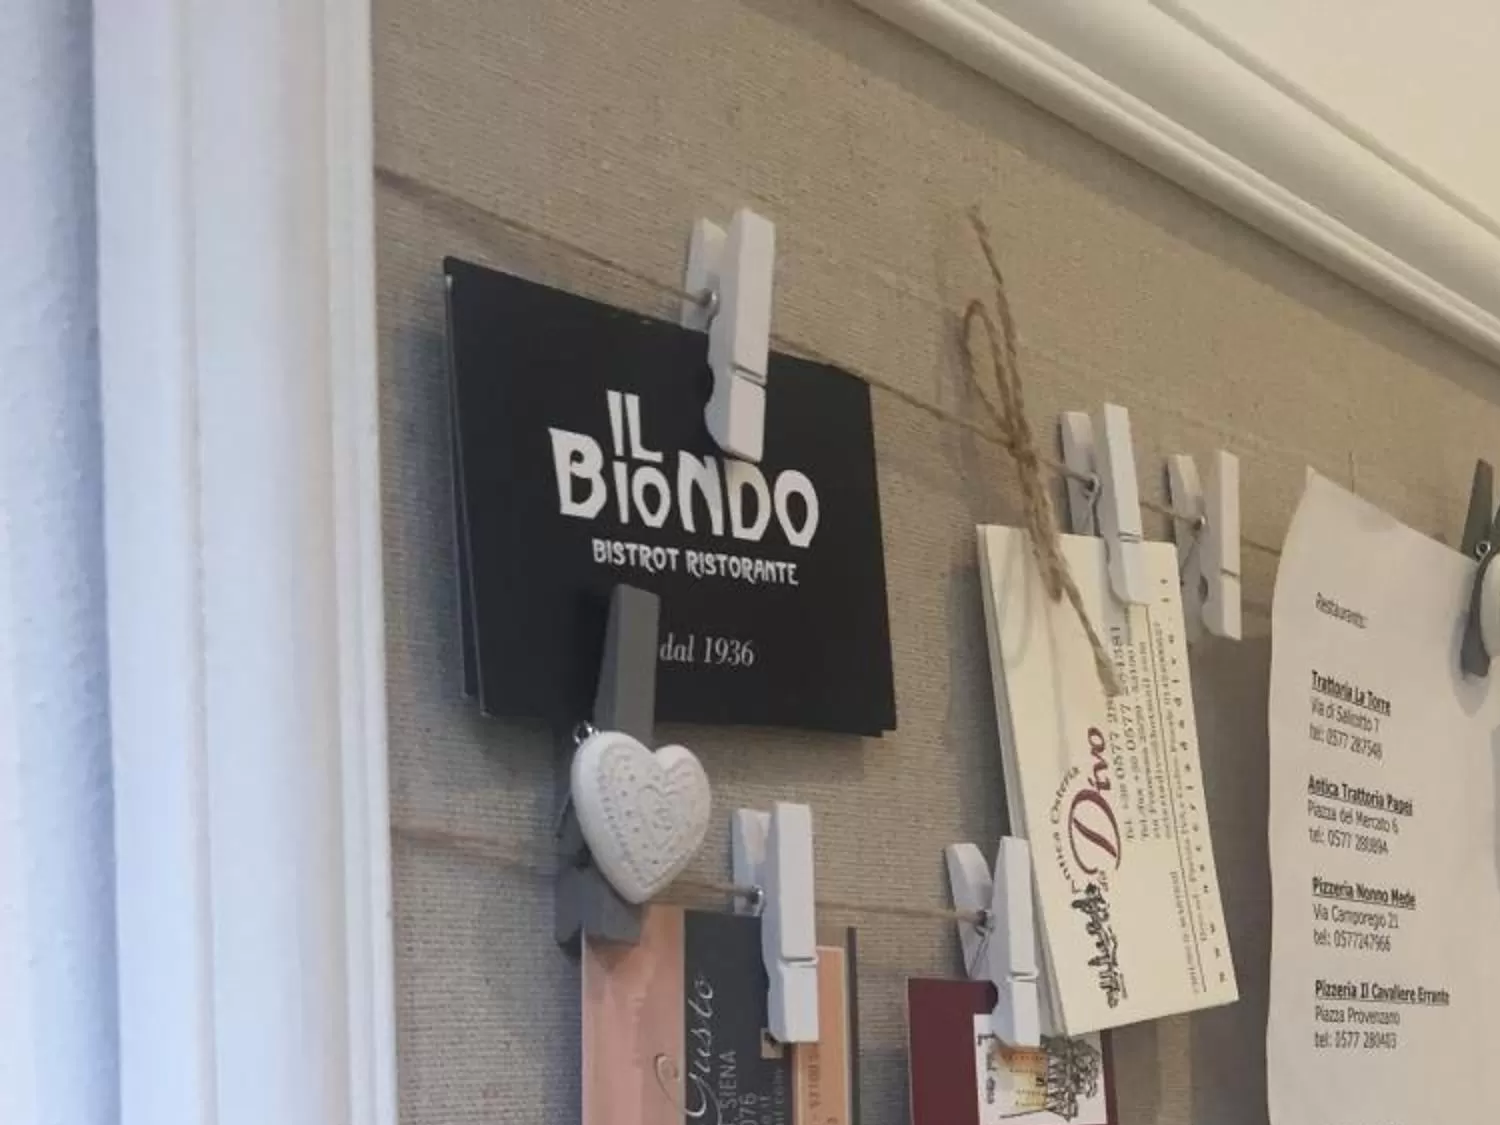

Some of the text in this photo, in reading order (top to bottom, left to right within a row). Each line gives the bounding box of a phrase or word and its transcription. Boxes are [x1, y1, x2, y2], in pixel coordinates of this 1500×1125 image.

[607, 389, 664, 463] IL
[548, 427, 820, 549] BIONDO
[591, 537, 799, 586] BISTROT RISTORANTE
[659, 634, 755, 667] dal 1936
[1312, 668, 1353, 702] Trattoria
[1066, 726, 1122, 876] Divo
[1307, 773, 1340, 798] Antica
[1341, 782, 1384, 808] Trattoria
[1307, 798, 1337, 821] Piazza
[1312, 876, 1354, 899] Pizzeria
[1356, 882, 1389, 903] Nonno
[1312, 903, 1329, 921] Via
[1315, 979, 1357, 1000] Pizzeria
[1371, 982, 1416, 1003] Cavaliere
[1315, 1005, 1401, 1026] Piazza Provenzano
[717, 1050, 739, 1109] SIENA
